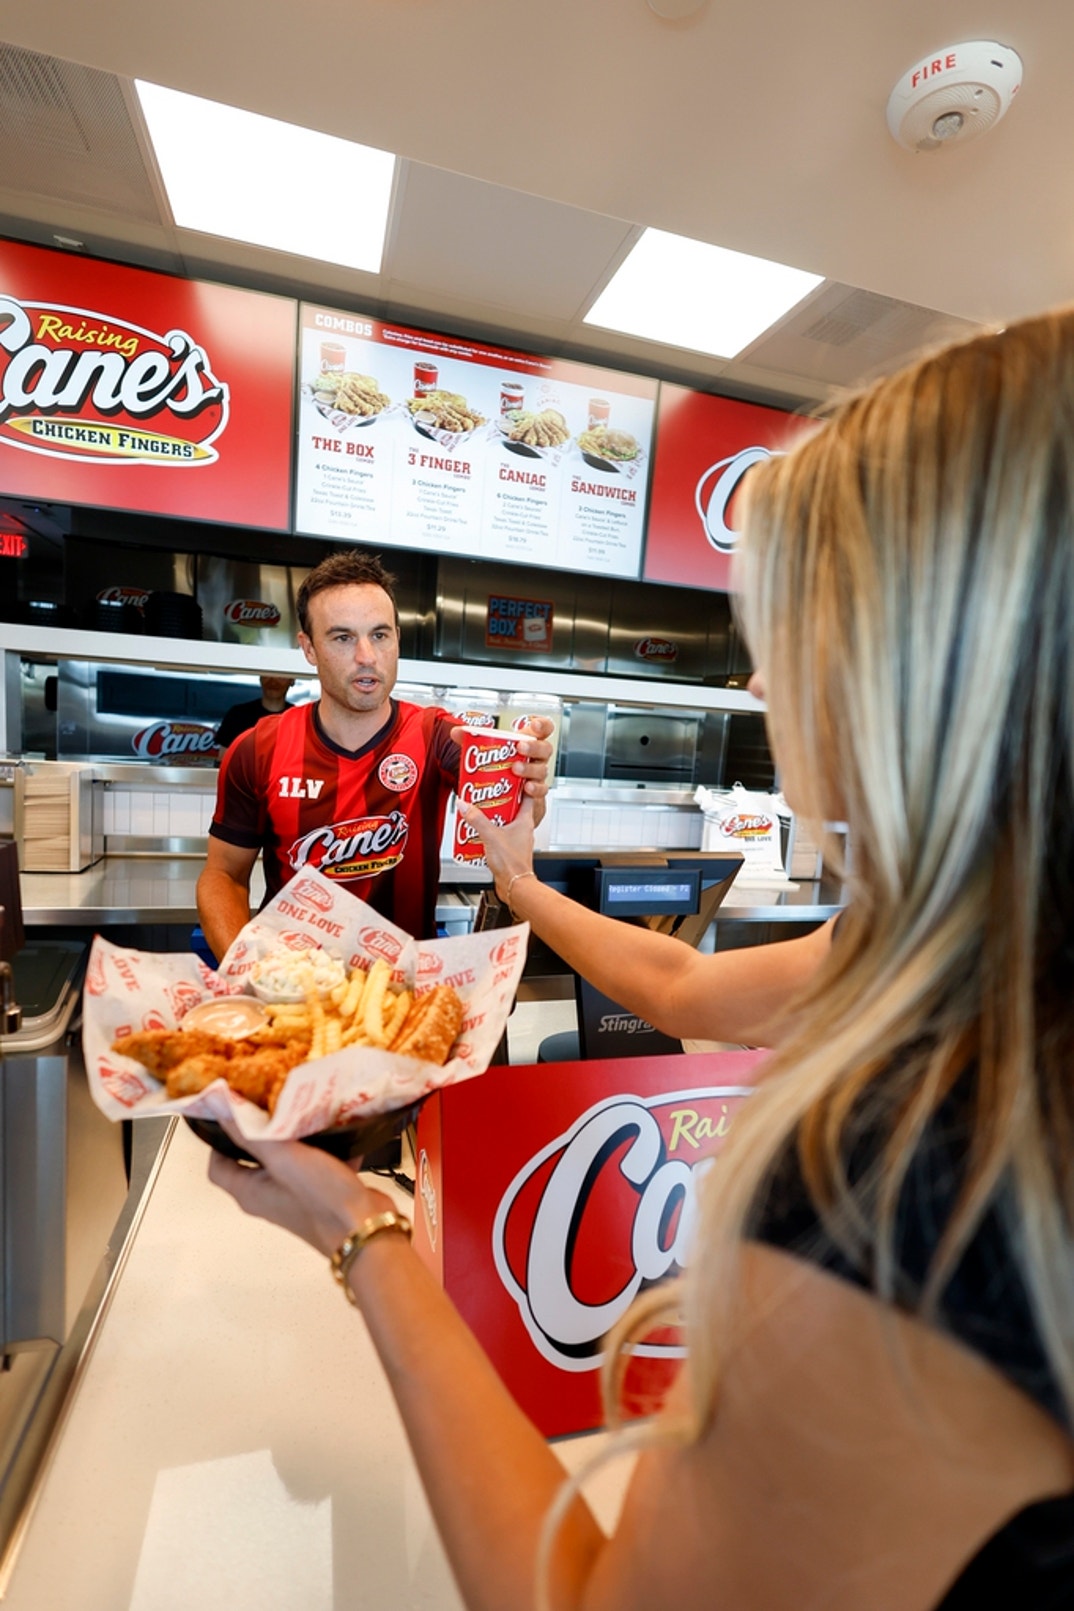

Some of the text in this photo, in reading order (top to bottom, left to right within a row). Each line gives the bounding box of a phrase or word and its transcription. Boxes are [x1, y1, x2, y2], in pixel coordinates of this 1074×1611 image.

[911, 54, 957, 88] FIRE
[36, 314, 140, 357] Raising
[315, 313, 373, 337] COMBOS
[31, 419, 194, 458] CHICKEN FINGERS
[311, 436, 375, 459] THE BOX
[321, 464, 348, 474] Chicken
[349, 469, 374, 479] Fingers
[407, 453, 472, 475] 3 FINGER
[417, 479, 442, 489] Chicken
[443, 484, 466, 493] Fingers
[499, 468, 547, 487] CANIAC
[502, 493, 525, 502] Chicken
[526, 497, 548, 506] Fingers
[571, 480, 637, 502] SANDWICH
[583, 506, 605, 514] Chicken
[606, 510, 627, 518] Fingers
[226, 599, 281, 623] Cane's
[489, 598, 551, 619] PERFECT
[489, 618, 517, 636] BOX
[634, 637, 676, 658] Cane's
[138, 720, 221, 759] Cane'
[464, 740, 518, 774] Cane's
[278, 776, 325, 799] 1LV
[460, 777, 513, 805] Cane's
[277, 899, 345, 938] ONE LOVE
